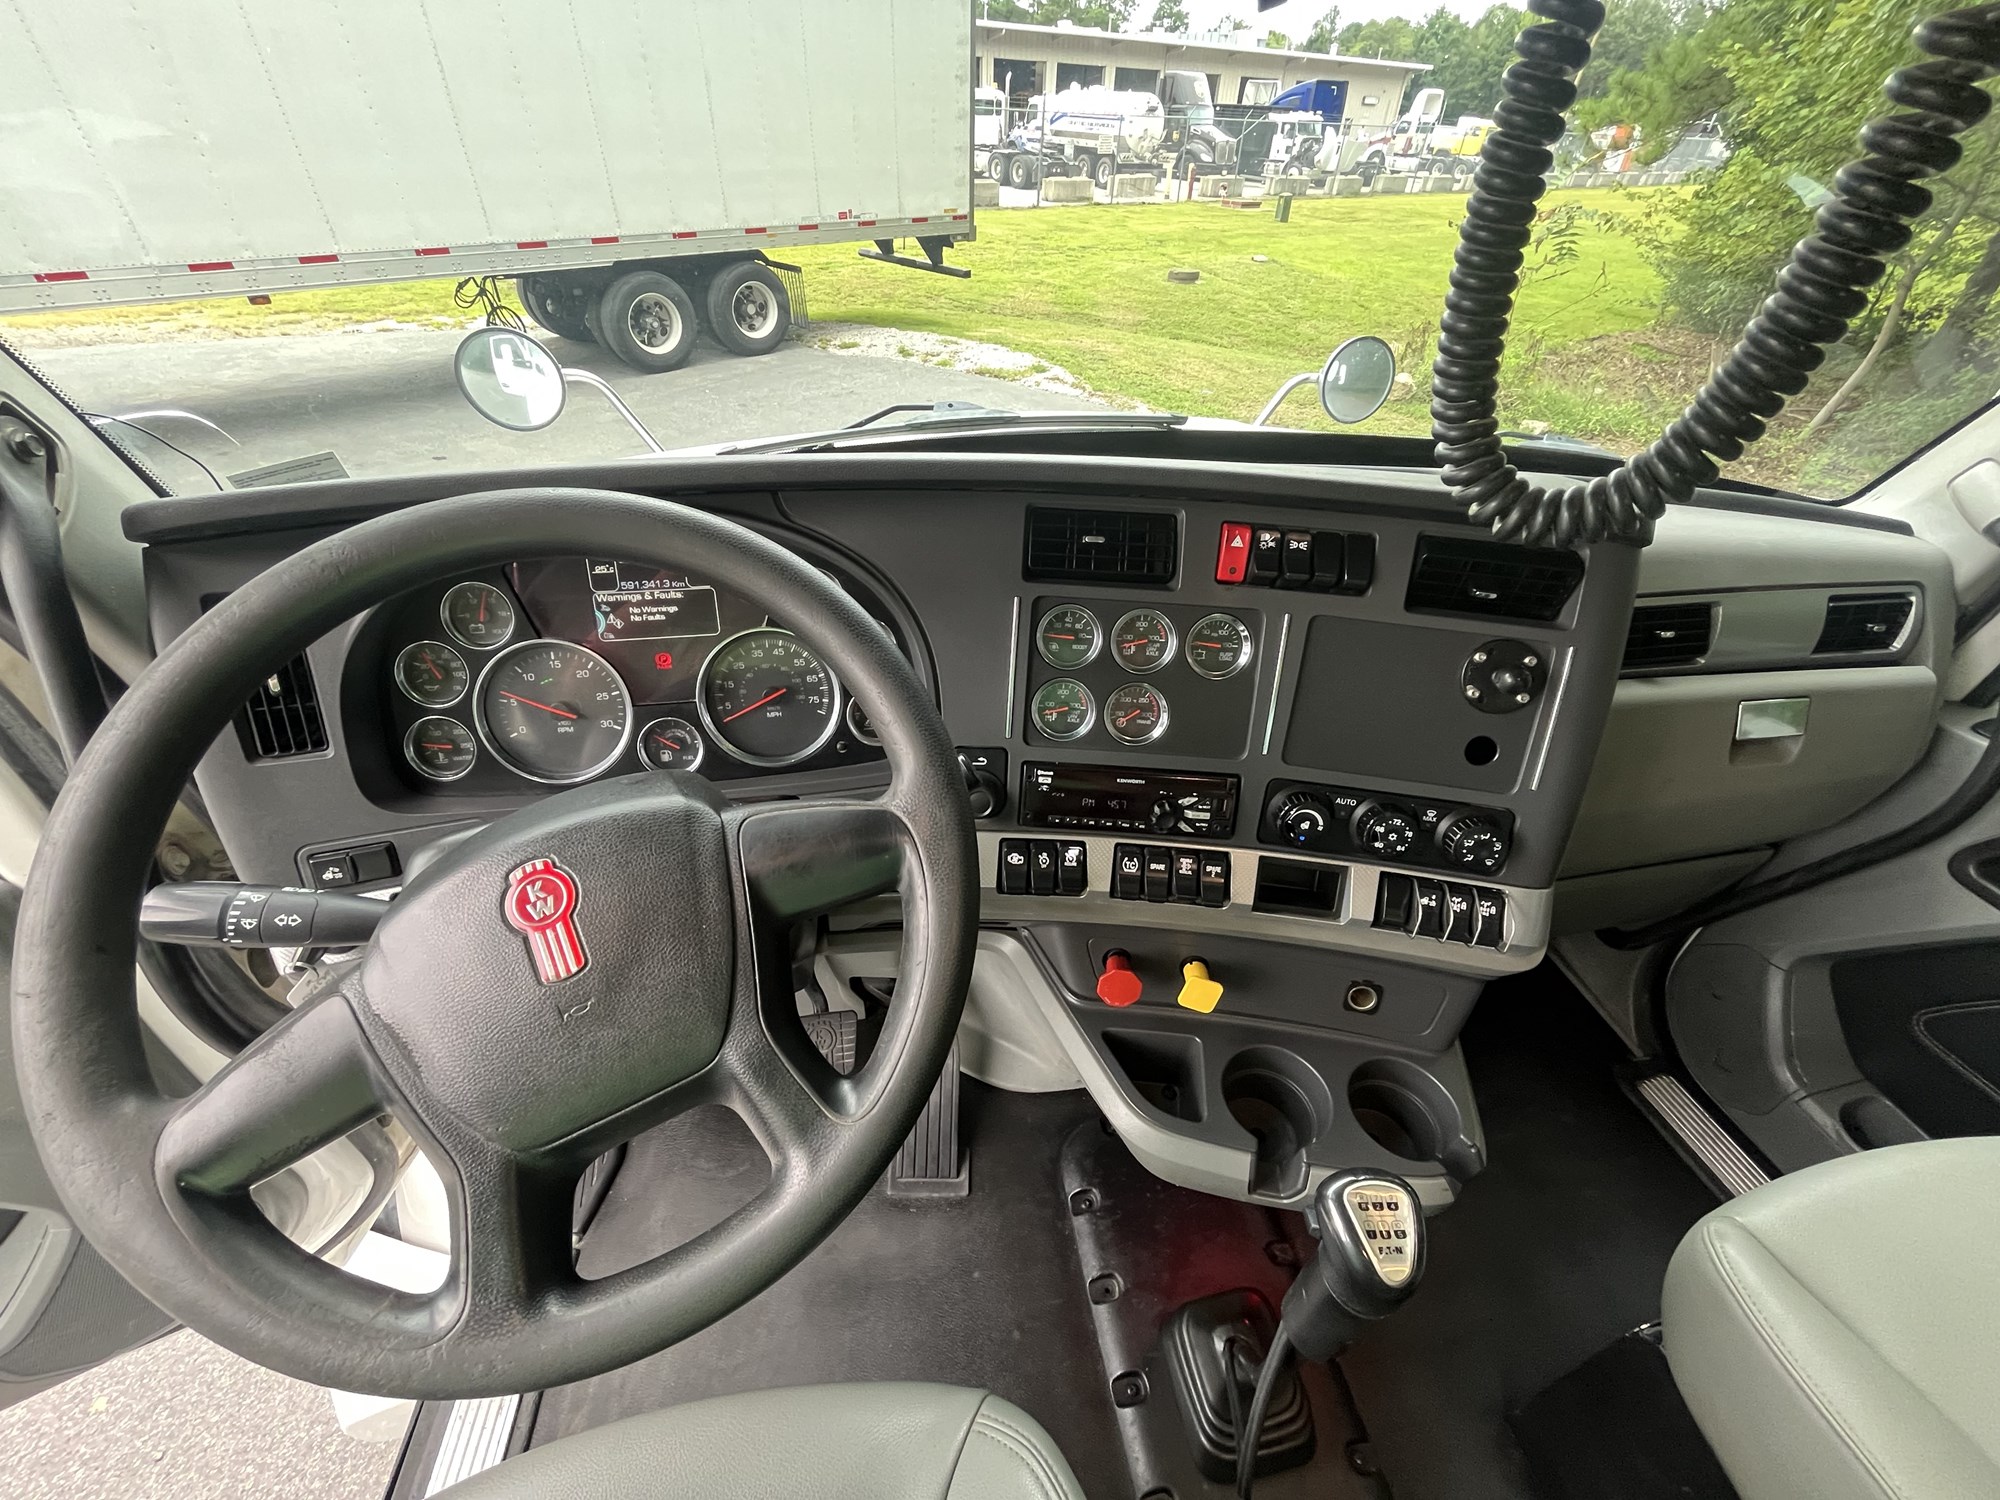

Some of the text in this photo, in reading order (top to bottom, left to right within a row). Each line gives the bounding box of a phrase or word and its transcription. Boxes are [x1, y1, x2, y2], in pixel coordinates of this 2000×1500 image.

[596, 591, 684, 603] Warnings & Faults:
[641, 605, 678, 613] Warnings
[772, 648, 784, 656] 45
[522, 673, 535, 681] 10
[576, 670, 589, 678] 20
[806, 675, 818, 683] 65
[596, 692, 609, 701] 25
[808, 696, 819, 704] 75
[600, 720, 614, 728] 30
[1082, 798, 1095, 806] PM
[1335, 797, 1357, 806] AUTO
[1150, 863, 1166, 871] SPARE
[1205, 865, 1222, 873] SPARE
[526, 880, 547, 903] K
[526, 895, 554, 920] W
